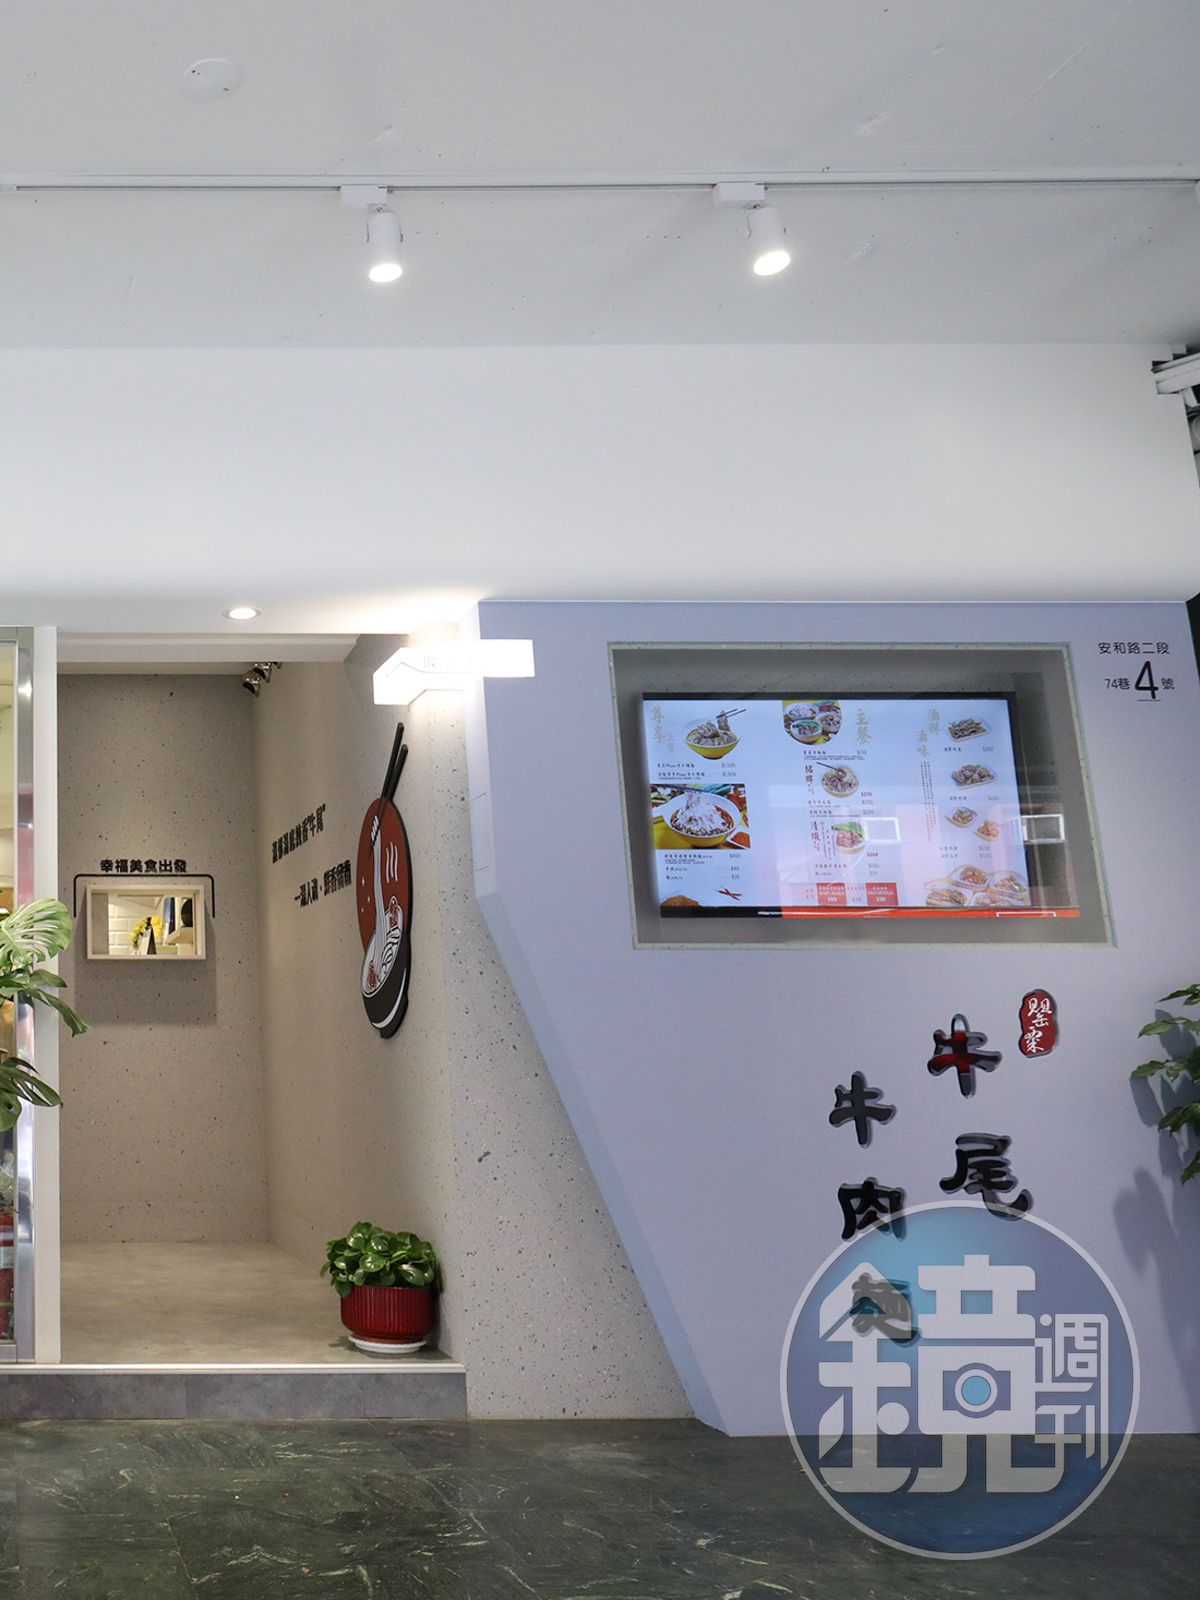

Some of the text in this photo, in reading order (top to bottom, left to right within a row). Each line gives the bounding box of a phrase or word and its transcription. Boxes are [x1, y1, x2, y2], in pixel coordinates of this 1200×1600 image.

[1098, 641, 1170, 655] 安和路二段
[100, 859, 188, 873] 幸福美食出發
[927, 1014, 1035, 1222] 牛尾
